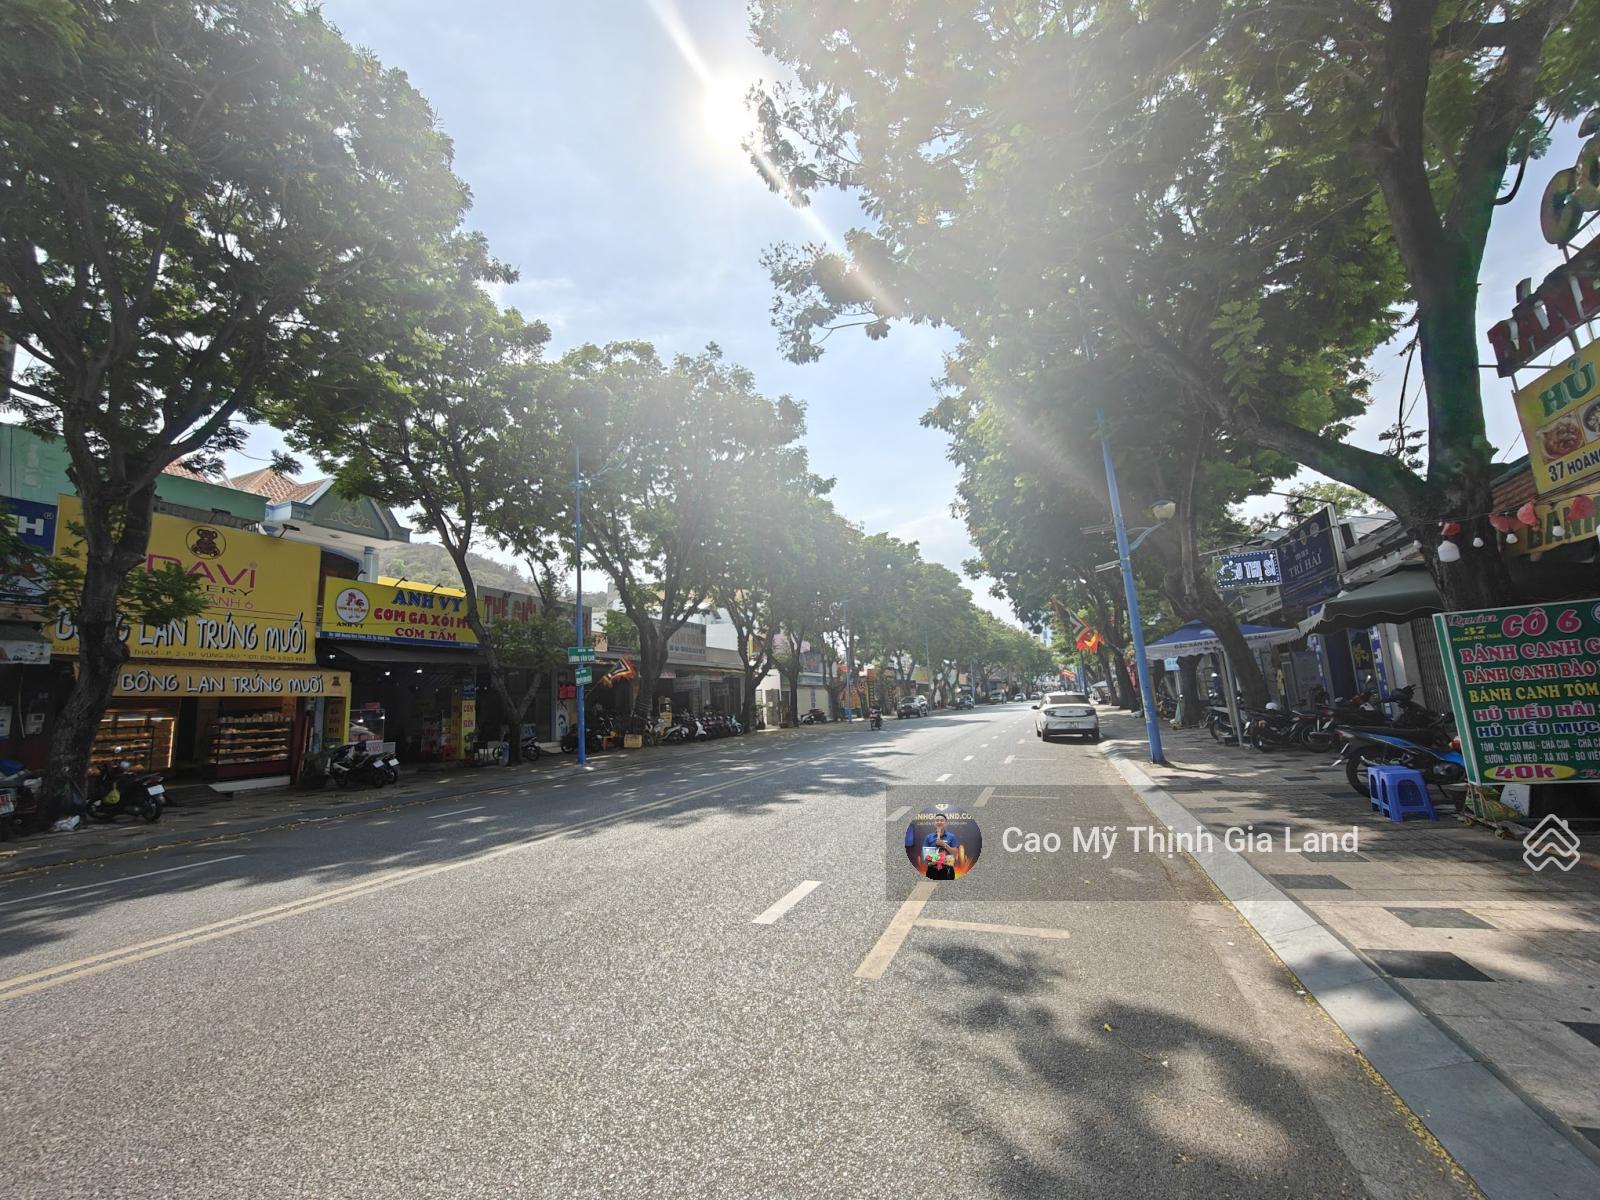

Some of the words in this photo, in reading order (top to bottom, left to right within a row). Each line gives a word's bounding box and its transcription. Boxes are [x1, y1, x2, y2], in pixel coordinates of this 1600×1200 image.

[1539, 354, 1598, 417] HỦ
[1548, 461, 1565, 482] 37
[1567, 448, 1600, 475] HOÀN
[391, 590, 435, 609] ANH
[438, 596, 463, 612] VY
[374, 607, 405, 623] CƠM
[408, 610, 428, 625] GÀ
[431, 611, 455, 627] XỐI
[1501, 607, 1549, 638] CÔ
[1556, 609, 1582, 633] 6
[139, 617, 188, 648] LAN
[196, 609, 258, 650] TRỨNG
[264, 609, 308, 653] MUỐI
[395, 626, 425, 638] CƠM
[428, 627, 457, 641] TẤM
[1459, 643, 1519, 665] BÁNH
[1520, 639, 1582, 658] CANH
[121, 669, 179, 693] BÔNG
[185, 674, 225, 692] LAN
[231, 671, 284, 693] TRỨNG
[287, 673, 324, 694] MUỐI
[1464, 666, 1509, 685] BÁNH
[1510, 664, 1557, 681] CANH
[1559, 658, 1596, 678] BÀO
[1468, 686, 1512, 702] BÁNH
[1515, 684, 1560, 700] CANH
[1563, 679, 1600, 697] TÔM
[1473, 704, 1502, 722] HỦ
[1504, 702, 1552, 721] TIẾU
[1555, 700, 1595, 717] HẢI
[1476, 722, 1504, 738] HỦ
[1505, 721, 1550, 737] TIẾU
[1552, 721, 1600, 736] MỰC
[1495, 765, 1555, 779] 40k
